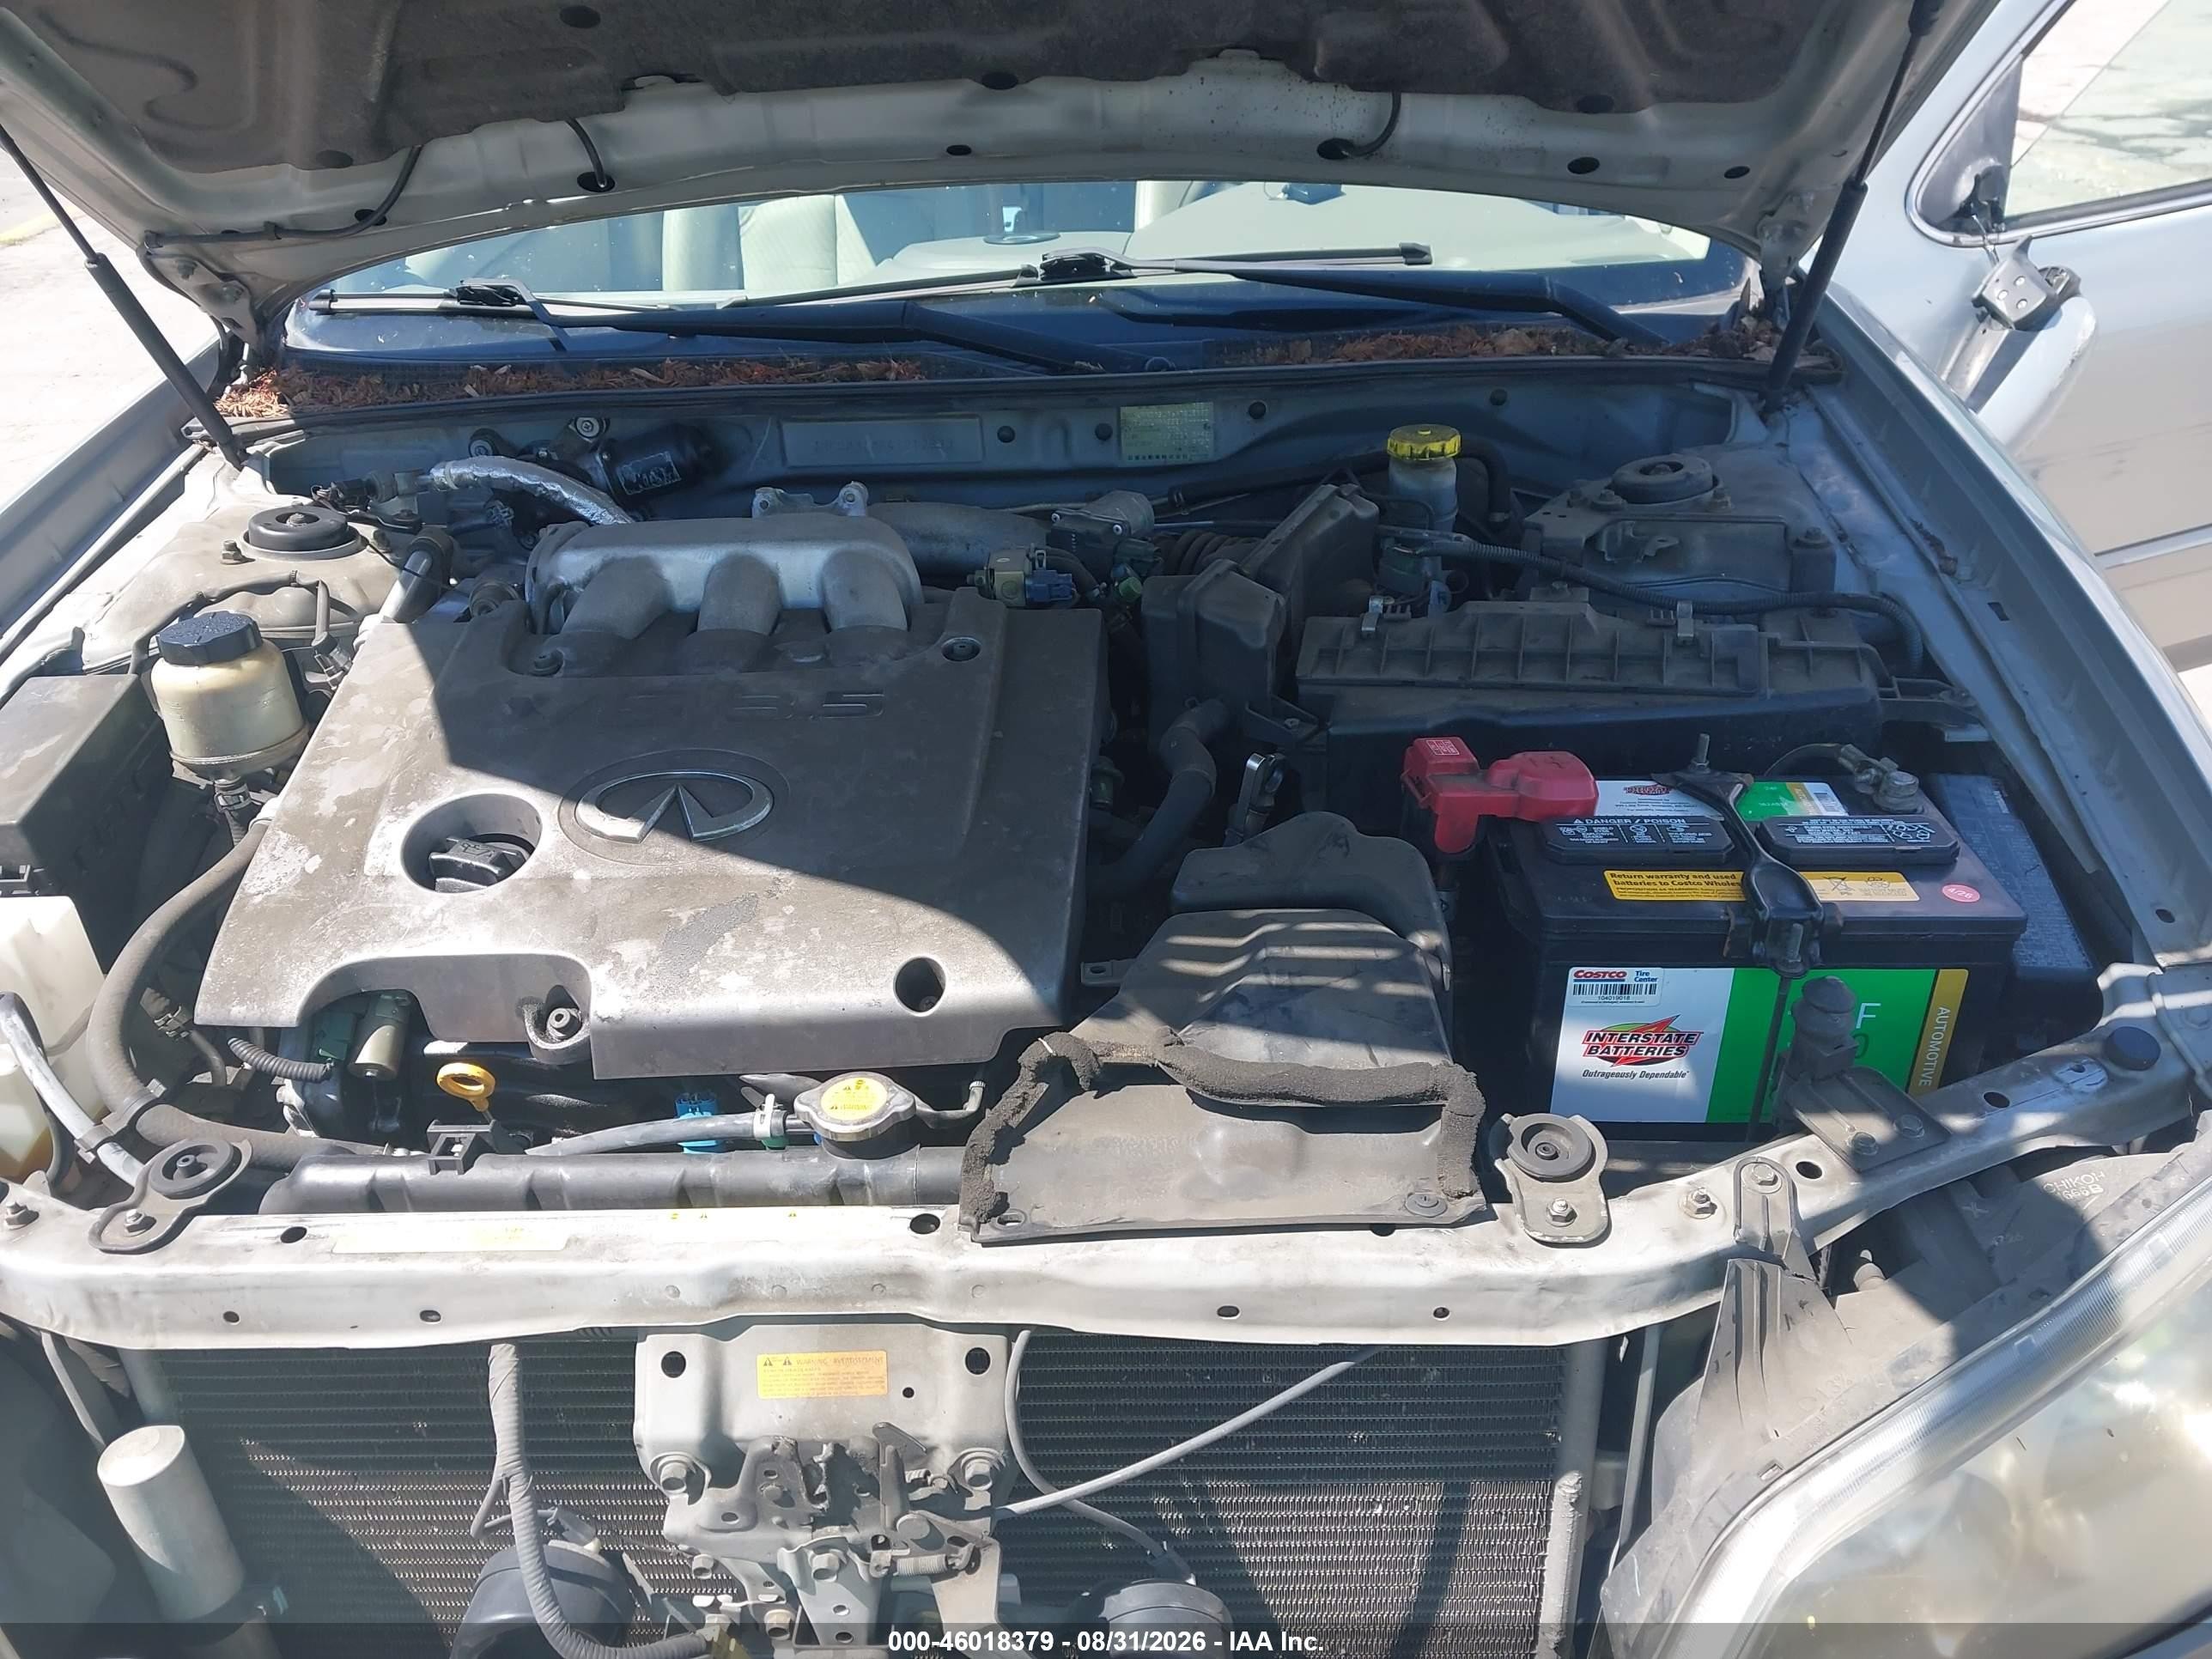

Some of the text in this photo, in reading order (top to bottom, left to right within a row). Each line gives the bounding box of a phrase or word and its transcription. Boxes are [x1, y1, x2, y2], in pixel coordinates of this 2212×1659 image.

[1573, 969, 1627, 979] COSTCO
[1585, 1032, 1699, 1044] INTERSTATE
[1587, 1045, 1688, 1056] BATTERIES
[1918, 1006, 1951, 1087] AUTOMOTIVE
[1582, 1069, 1637, 1080] Outrageously
